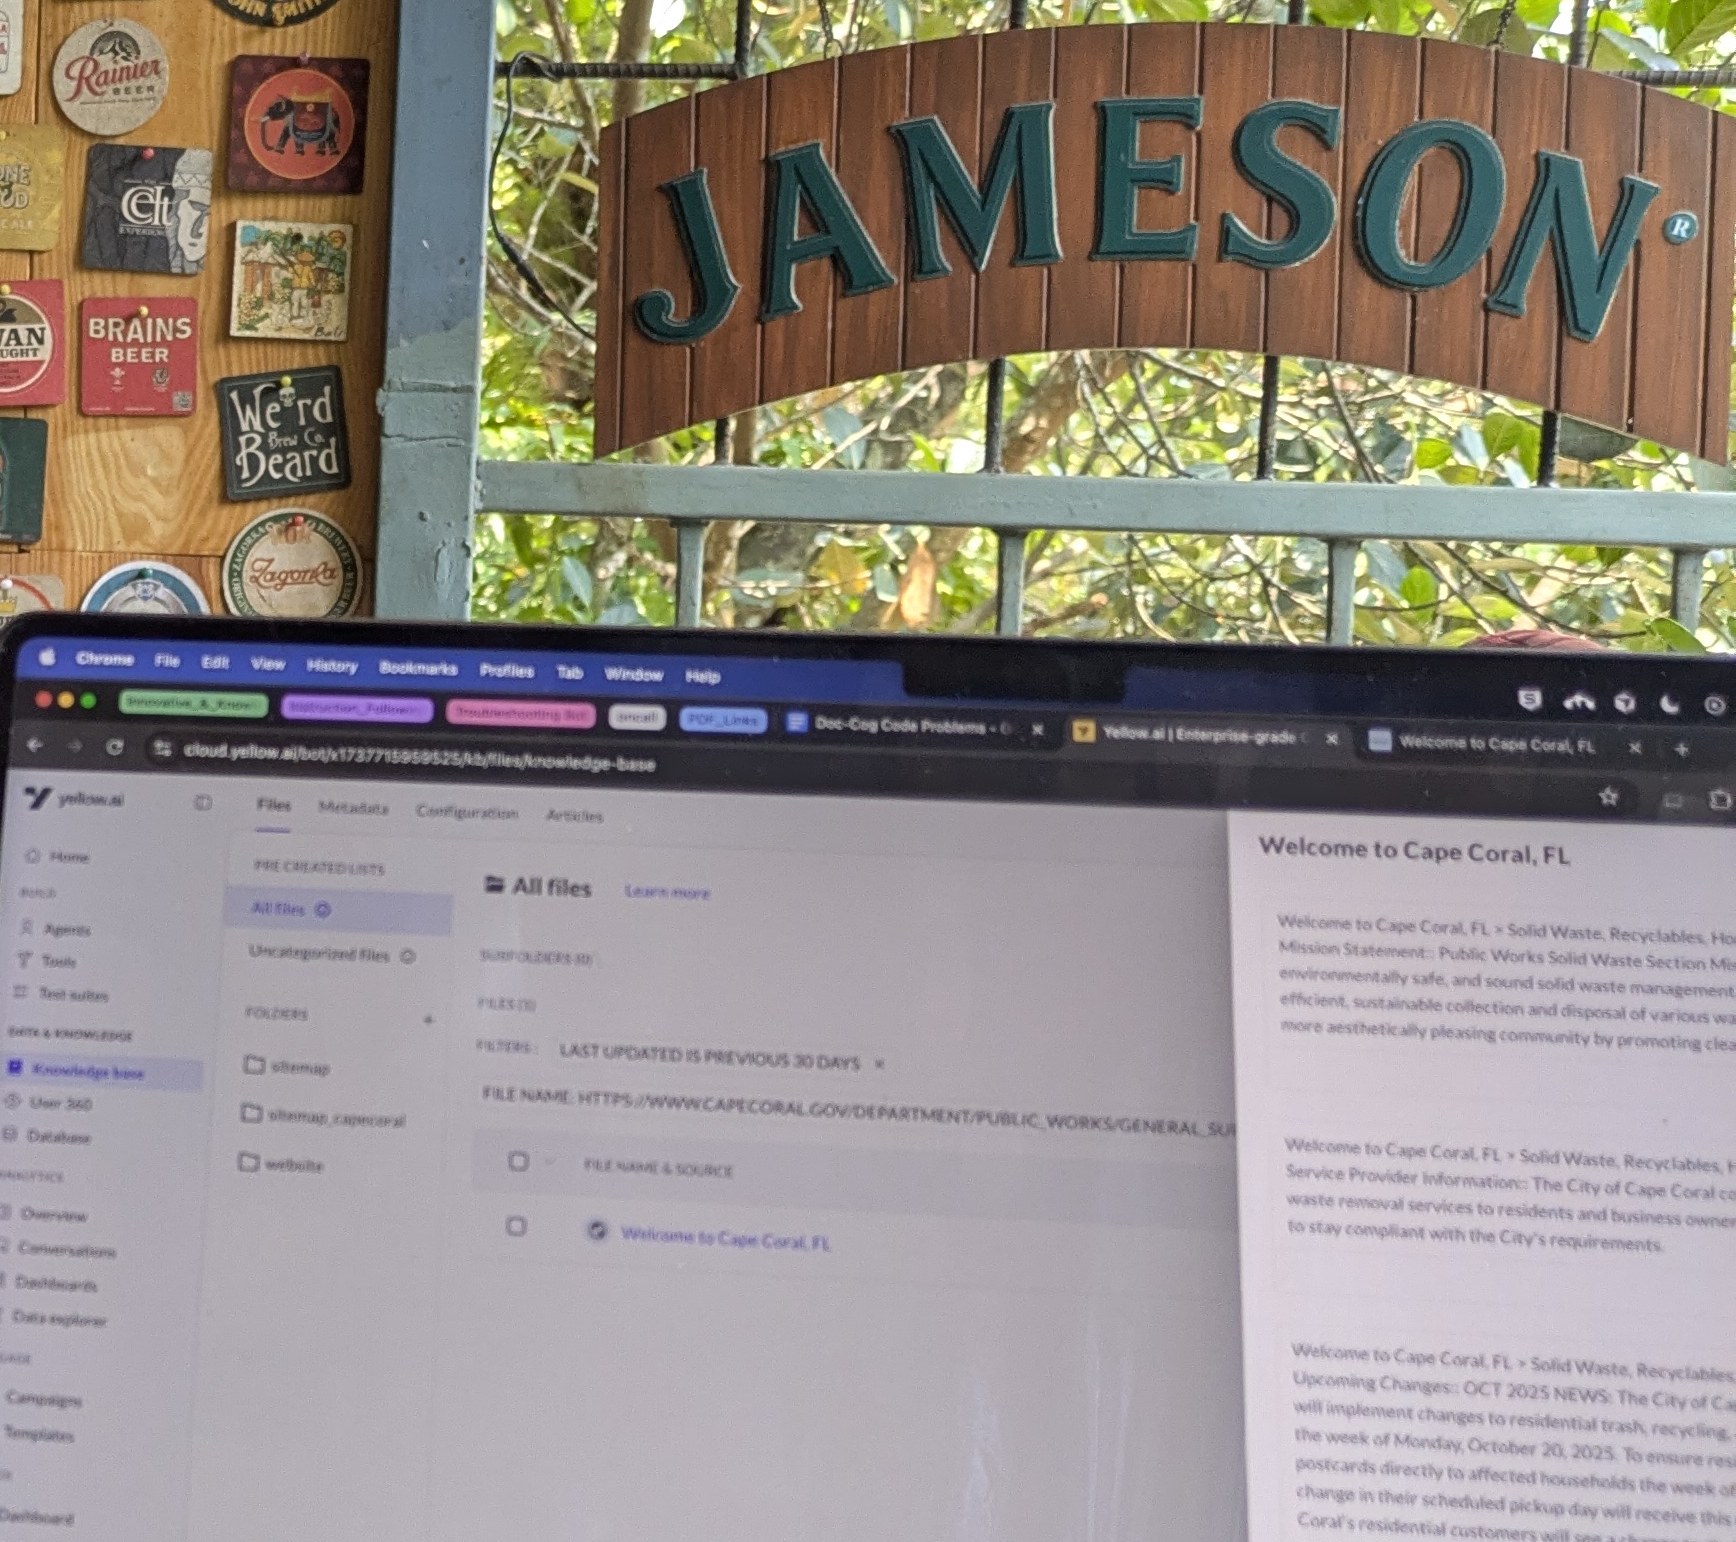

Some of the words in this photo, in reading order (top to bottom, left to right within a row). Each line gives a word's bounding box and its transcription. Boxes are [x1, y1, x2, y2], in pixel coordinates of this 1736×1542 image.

[65, 56, 163, 102] Rainier
[112, 85, 155, 96] BEER
[634, 94, 1661, 345] JAMESON
[88, 317, 192, 343] BRAINS
[111, 348, 169, 363] BEER
[235, 432, 339, 487] Beard
[76, 651, 135, 668] Chrome
[154, 653, 181, 669] File
[201, 655, 229, 671] Edit
[251, 657, 286, 672] View
[306, 658, 359, 676] History
[378, 660, 459, 677] Bookmarks
[557, 664, 584, 680] Tab
[604, 666, 663, 683] Window
[686, 668, 722, 687] Help
[1259, 835, 1368, 859] Welcome
[1374, 842, 1398, 859] to
[1402, 841, 1462, 864] Cape
[1467, 843, 1538, 867] Coral,
[1542, 846, 1570, 865] FL
[512, 878, 542, 897] All
[547, 878, 592, 899] files
